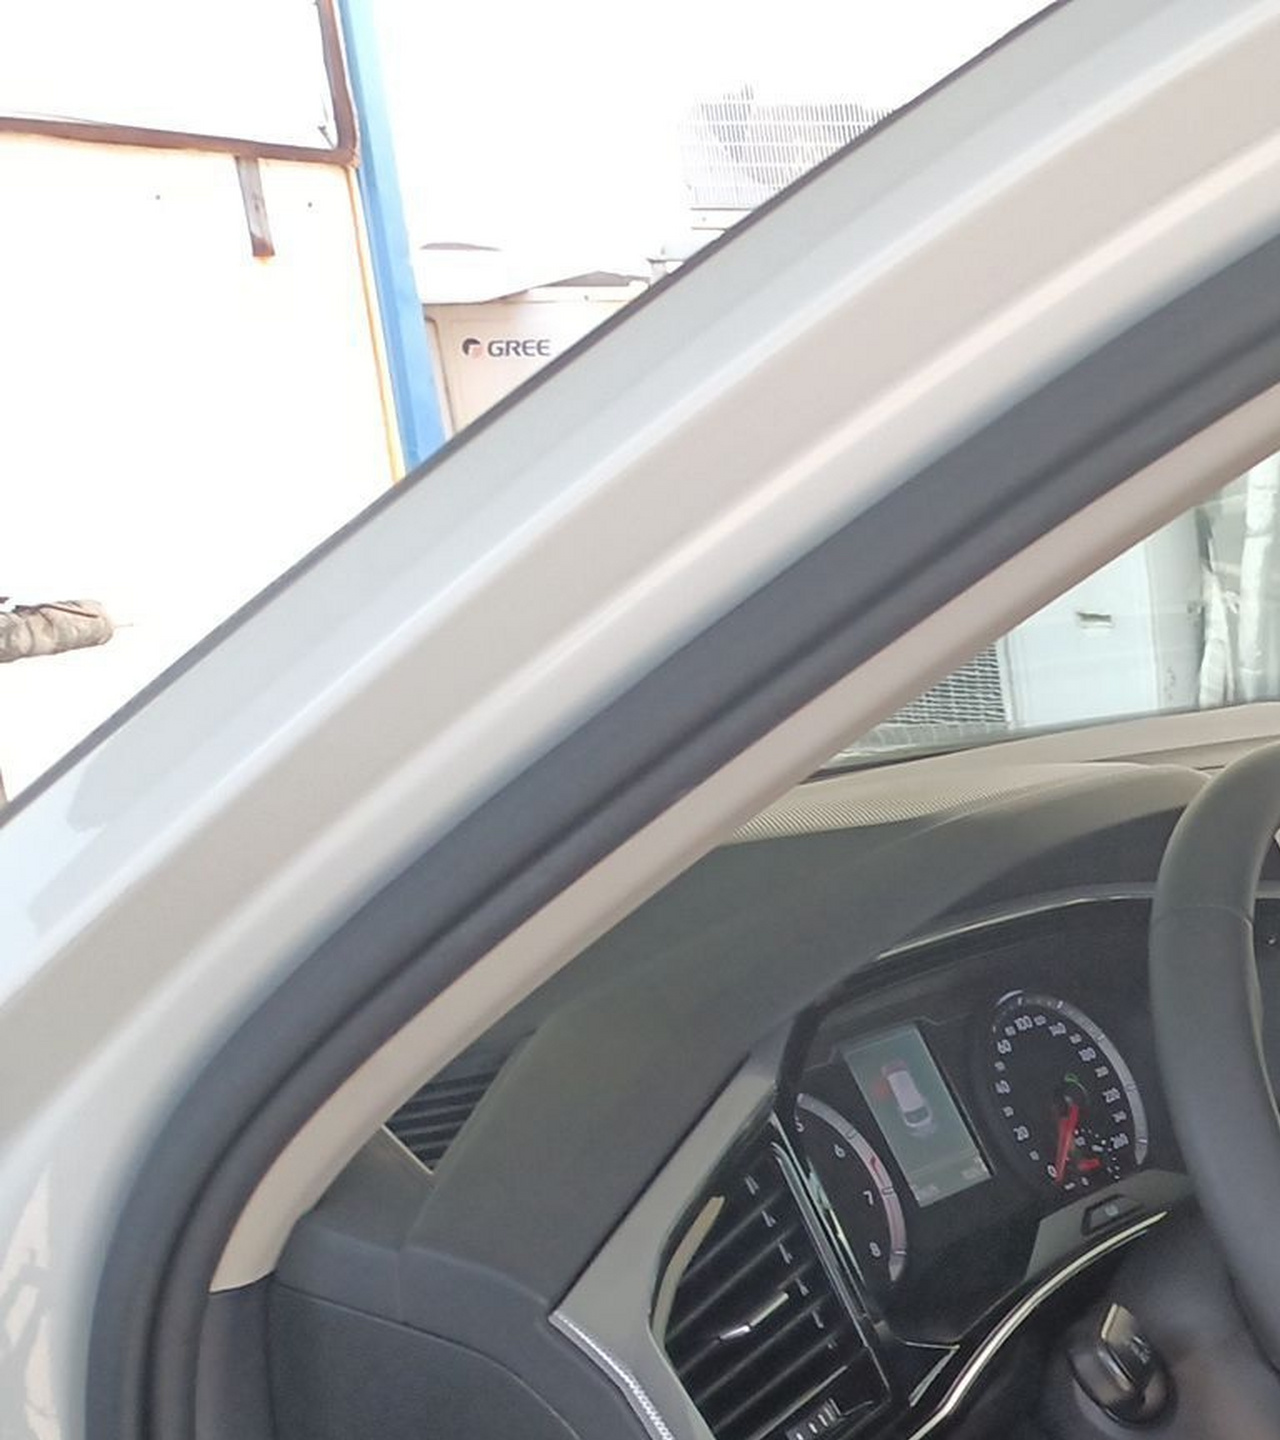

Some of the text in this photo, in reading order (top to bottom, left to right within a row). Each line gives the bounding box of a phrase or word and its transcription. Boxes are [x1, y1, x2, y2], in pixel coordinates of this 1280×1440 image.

[487, 339, 552, 358] GREE
[833, 1143, 846, 1158] 6
[863, 1190, 874, 1205] 7
[869, 1241, 881, 1257] 8
